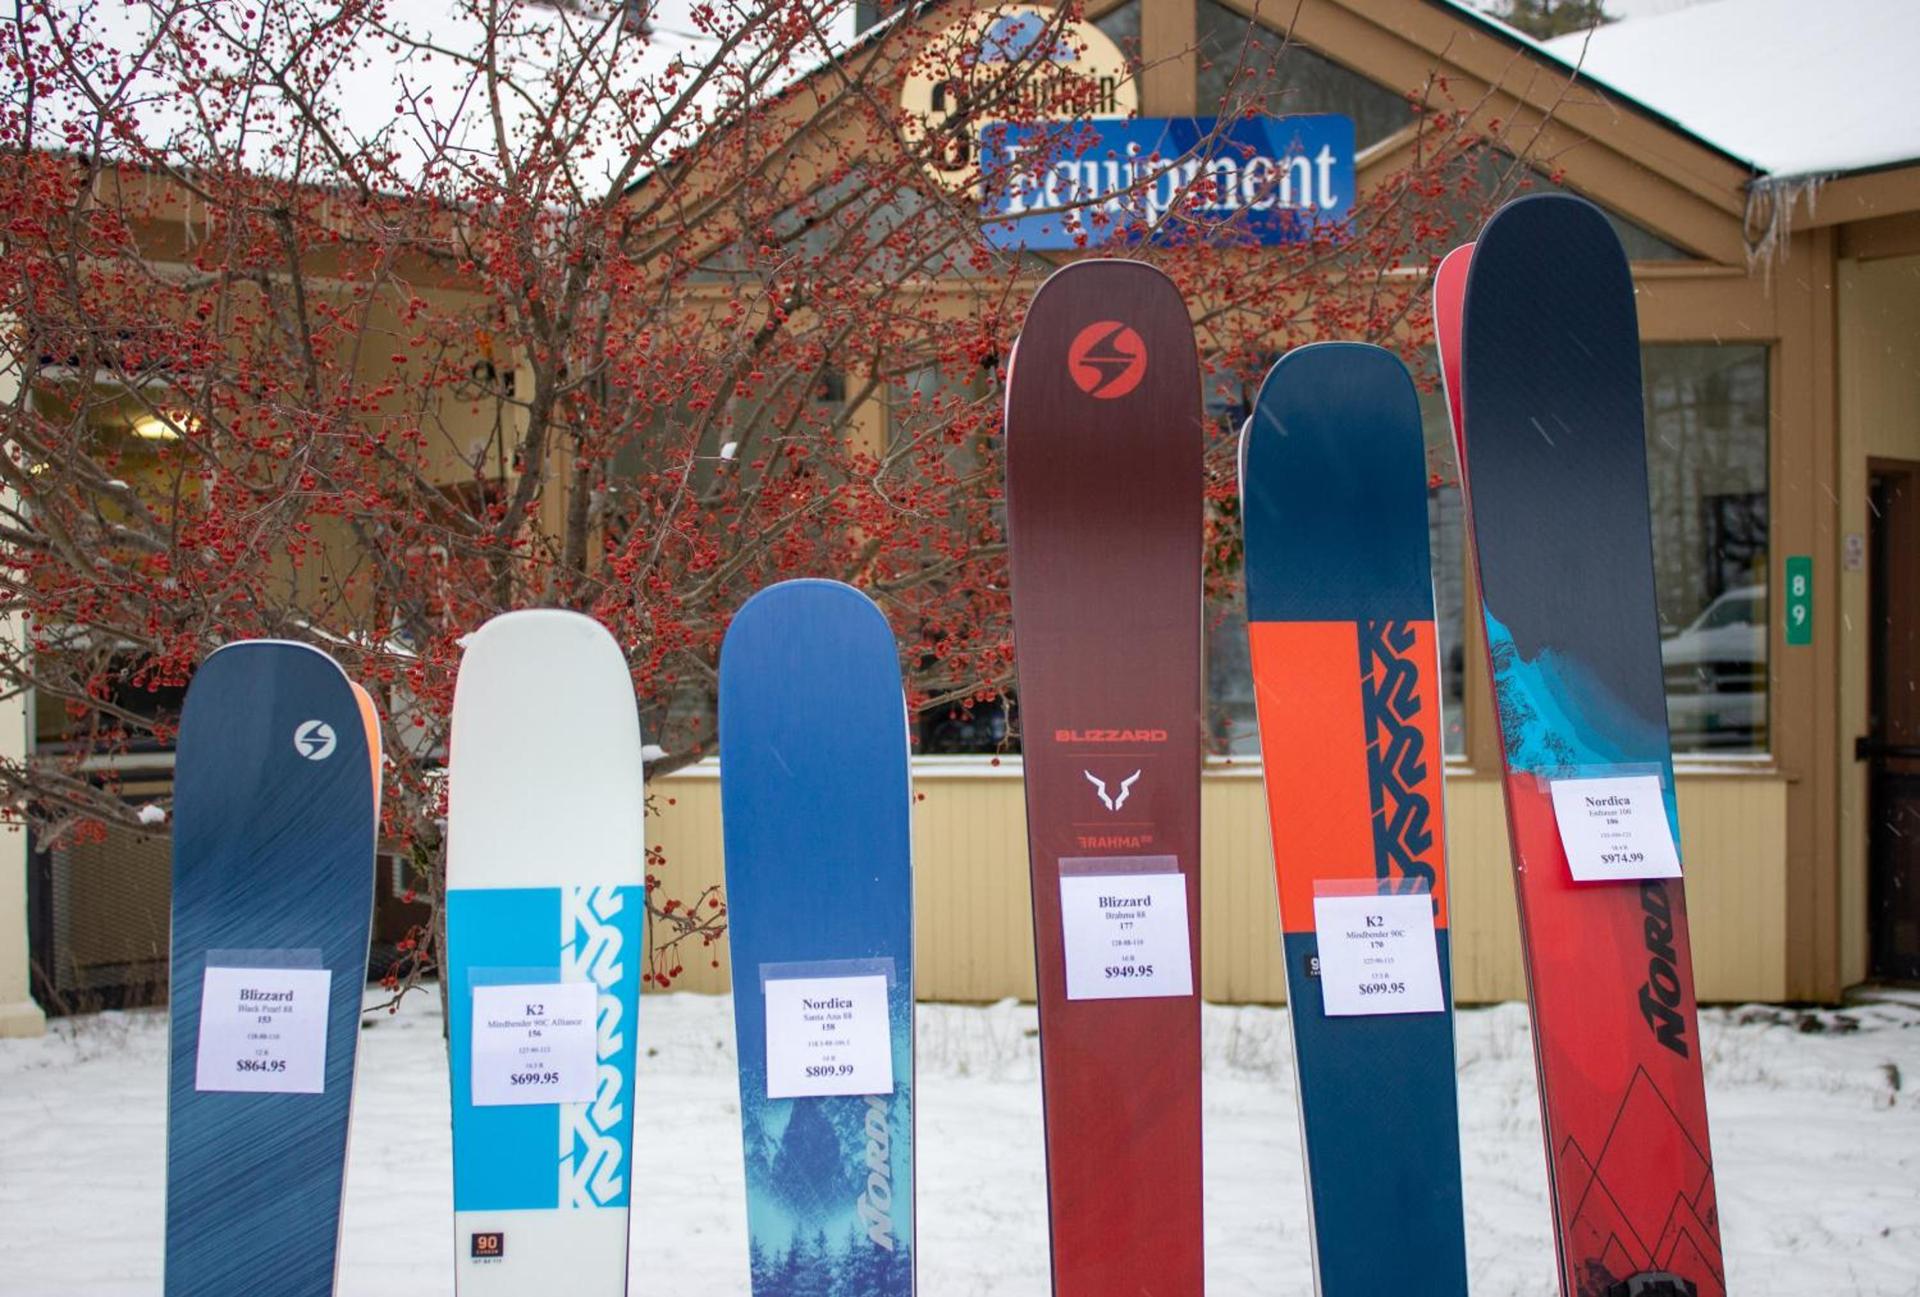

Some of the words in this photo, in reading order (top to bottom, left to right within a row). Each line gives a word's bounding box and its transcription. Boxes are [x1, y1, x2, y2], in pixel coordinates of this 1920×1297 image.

[1004, 140, 1338, 235] Equipment
[1362, 659, 1421, 749] K2
[1055, 729, 1168, 742] BLIZZARD
[1367, 726, 1426, 817] K2
[1585, 796, 1631, 807] Nordica
[1372, 793, 1432, 884] K2
[1601, 852, 1644, 864] $974.99
[1099, 895, 1152, 908] Blizzard
[1120, 922, 1133, 930] 177
[1366, 916, 1384, 927] K2
[1346, 931, 1389, 939] Mindbender
[1105, 965, 1154, 978] $949.95
[1359, 982, 1405, 995] $699.95
[240, 989, 294, 1001] Blizzard
[238, 1005, 259, 1013] Black
[526, 1004, 544, 1016] K2
[802, 998, 853, 1010] Nordica
[488, 1020, 532, 1028] Mindbender
[236, 1060, 286, 1072] $864.95
[805, 1064, 854, 1077] $809.99
[510, 1072, 559, 1085] $699.95
[478, 1236, 497, 1249] 90
